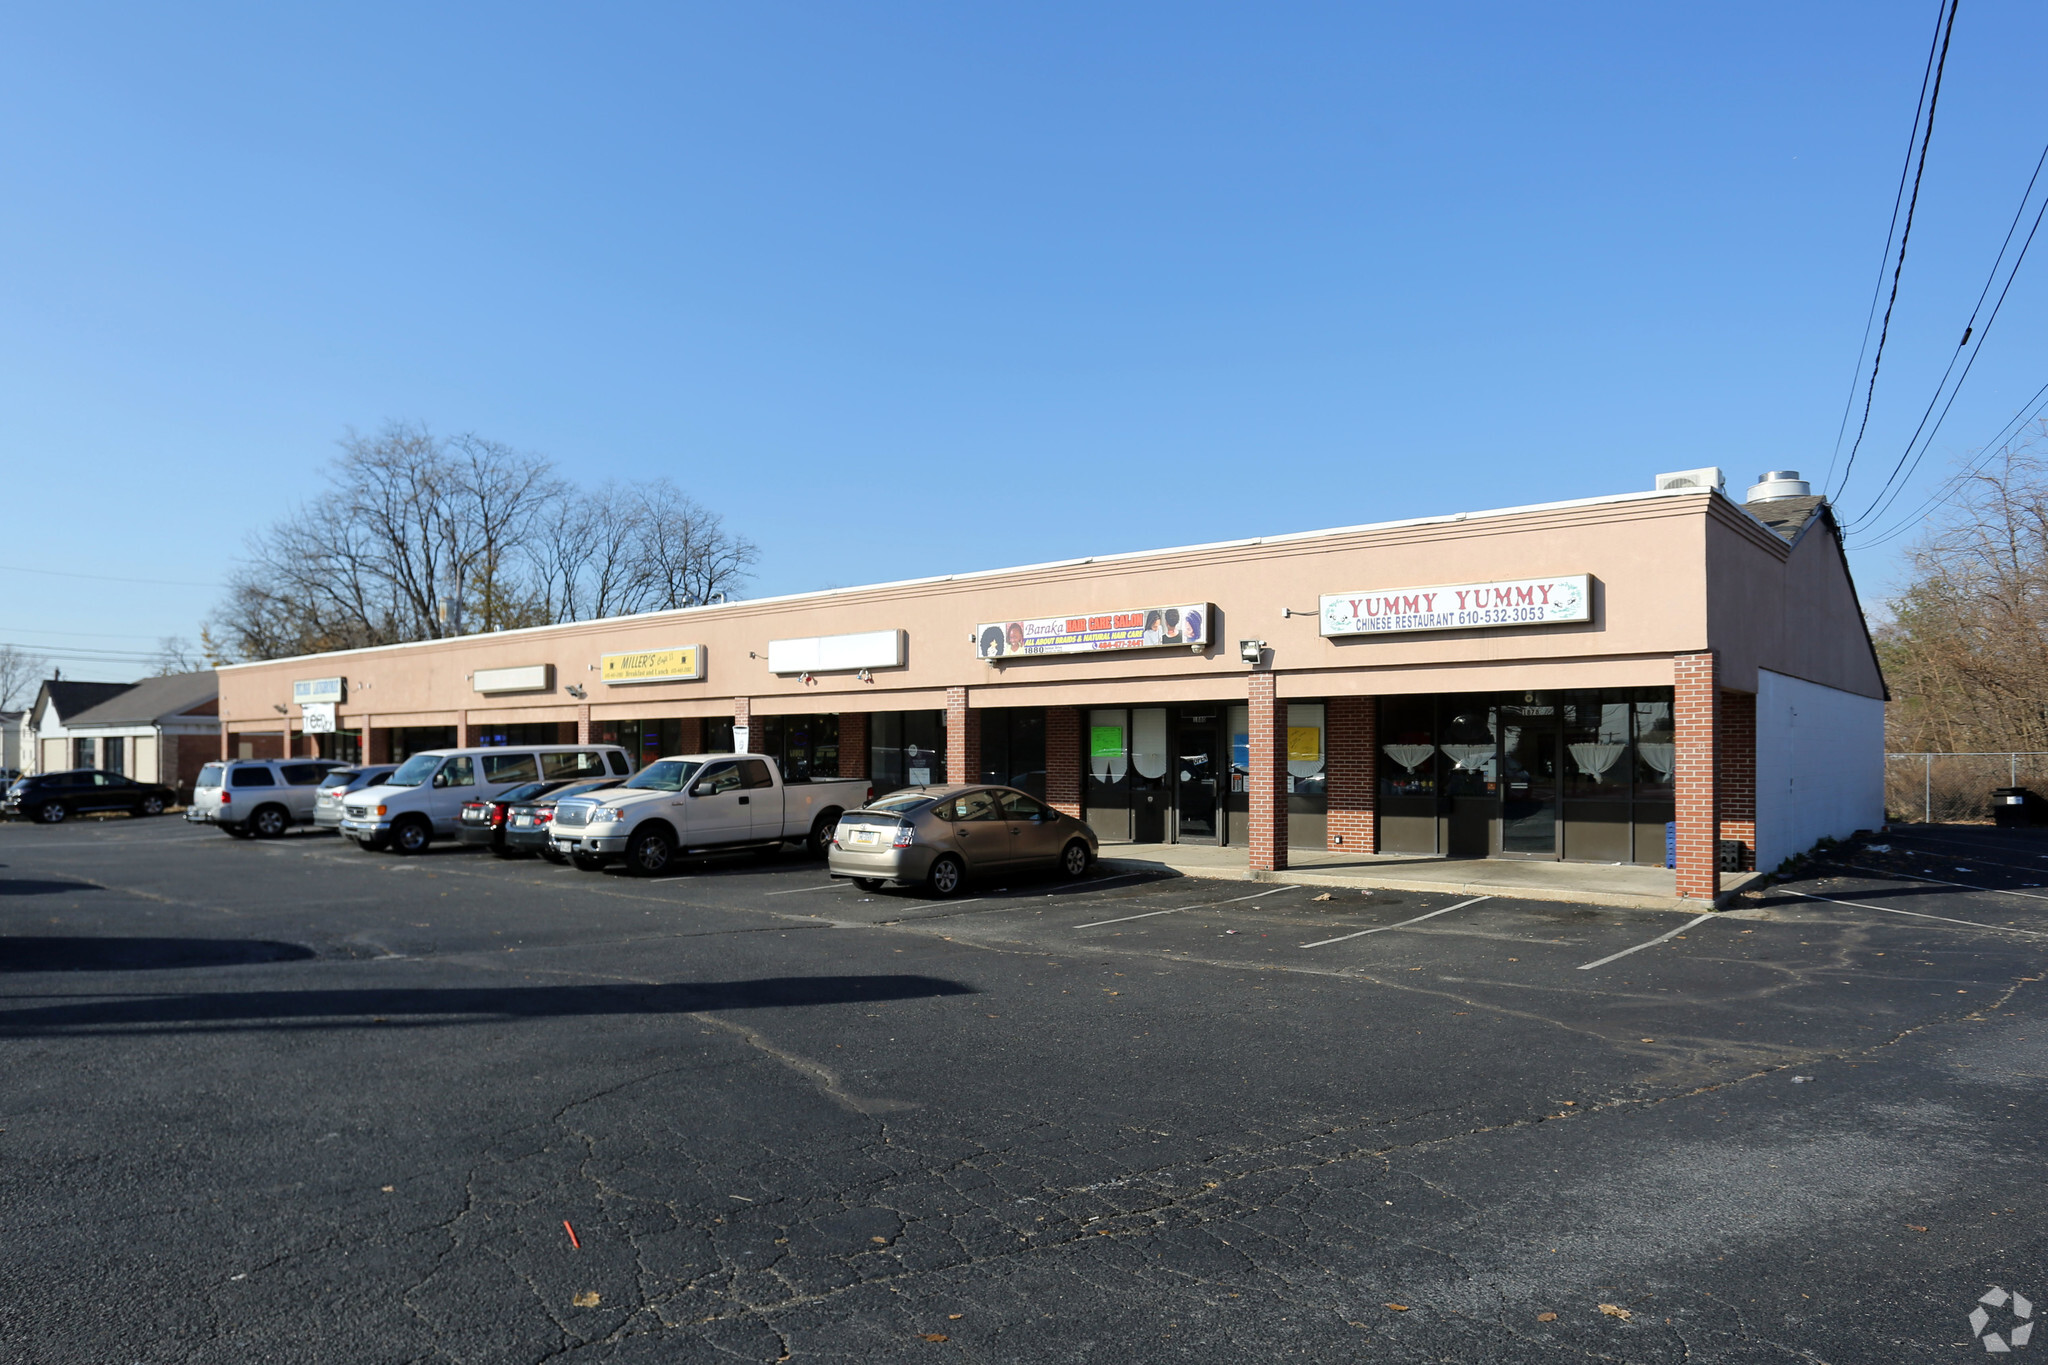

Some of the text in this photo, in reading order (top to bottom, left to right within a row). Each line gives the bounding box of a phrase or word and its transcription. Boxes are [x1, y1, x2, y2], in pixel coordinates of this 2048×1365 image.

[1349, 584, 1554, 618] YUMMY YUMMY
[1025, 613, 1144, 636] Baraka HAIR CARE SALON
[1356, 607, 1544, 631] CHINESE RESTAURANT 610-532-3053
[1025, 638, 1035, 646] ALL
[1035, 637, 1055, 645] ABOUT
[1055, 635, 1077, 644] BRAIDS
[1083, 632, 1110, 642] NATURAL
[1111, 631, 1126, 640] HAIR
[1127, 630, 1144, 638] CARE
[1024, 646, 1044, 654] 1880
[621, 654, 656, 669] MILLER'S
